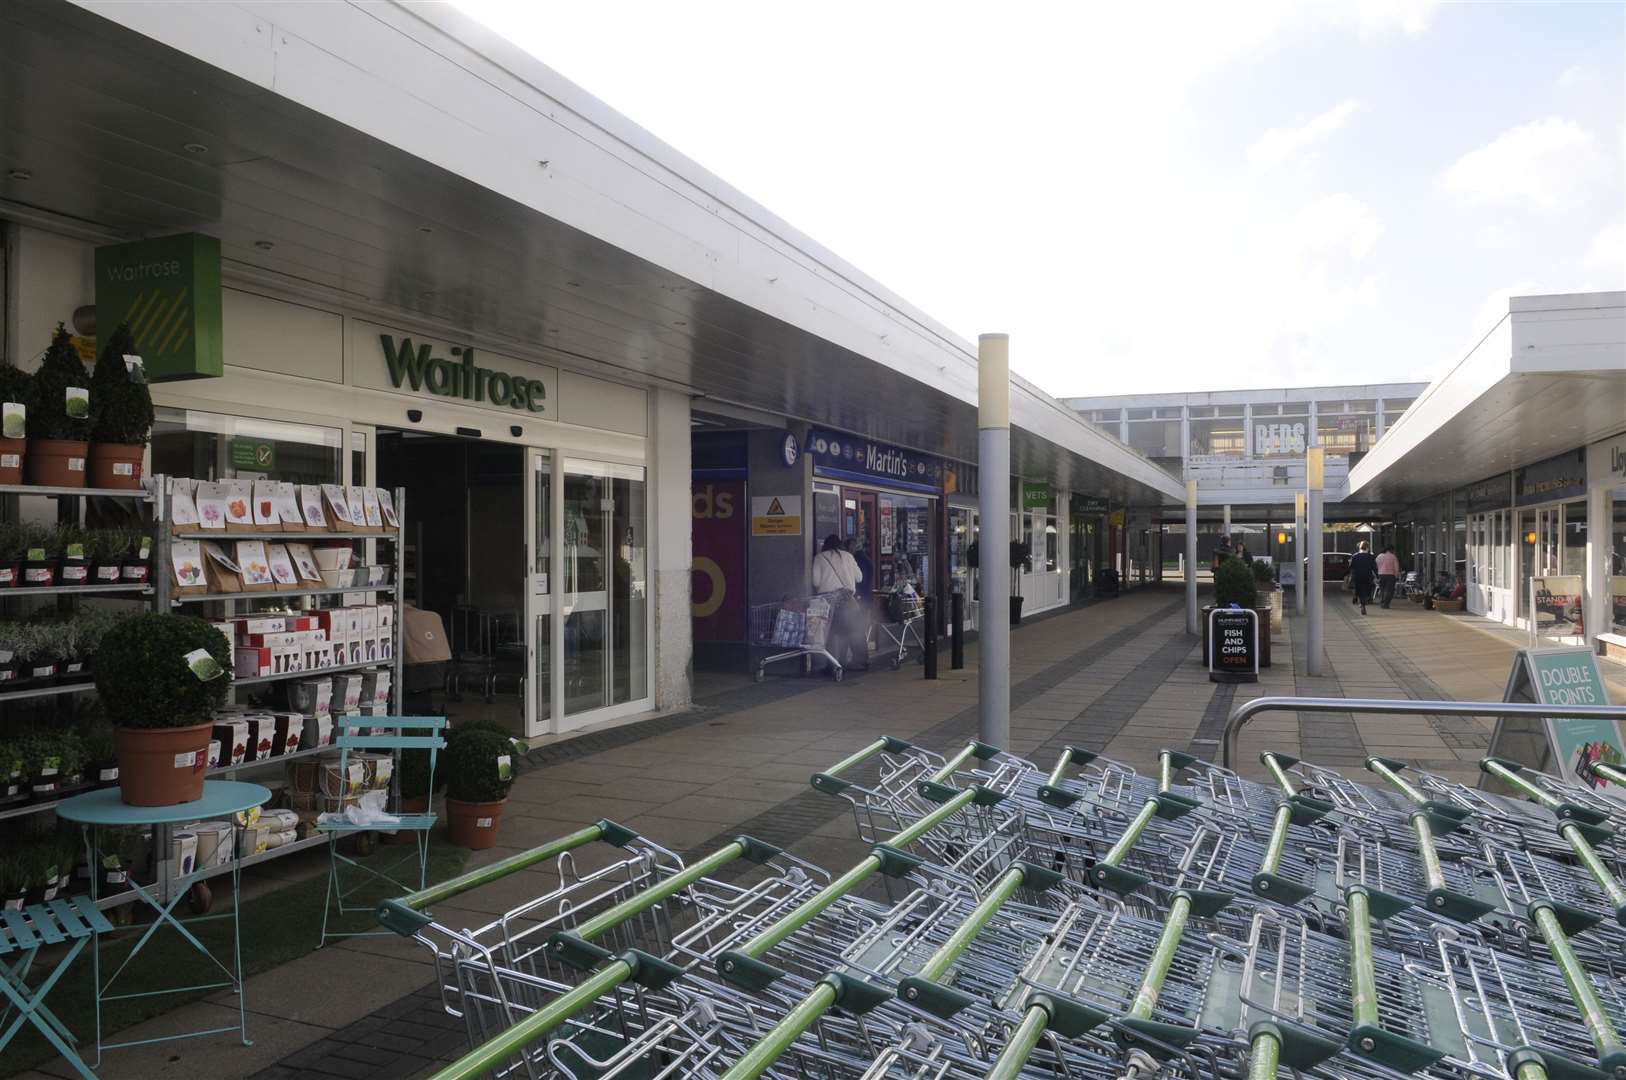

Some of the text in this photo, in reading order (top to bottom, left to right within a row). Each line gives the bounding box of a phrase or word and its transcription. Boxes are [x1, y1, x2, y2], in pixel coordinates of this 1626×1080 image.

[107, 259, 181, 281] Waitrose
[380, 334, 547, 413] Waitrose
[1256, 423, 1305, 454] BEDS
[866, 444, 907, 476] Martin's
[1025, 490, 1048, 500] VETS
[1224, 629, 1243, 637] FISH
[1541, 666, 1592, 686] DOUBLE
[1549, 687, 1596, 704] POINTS
